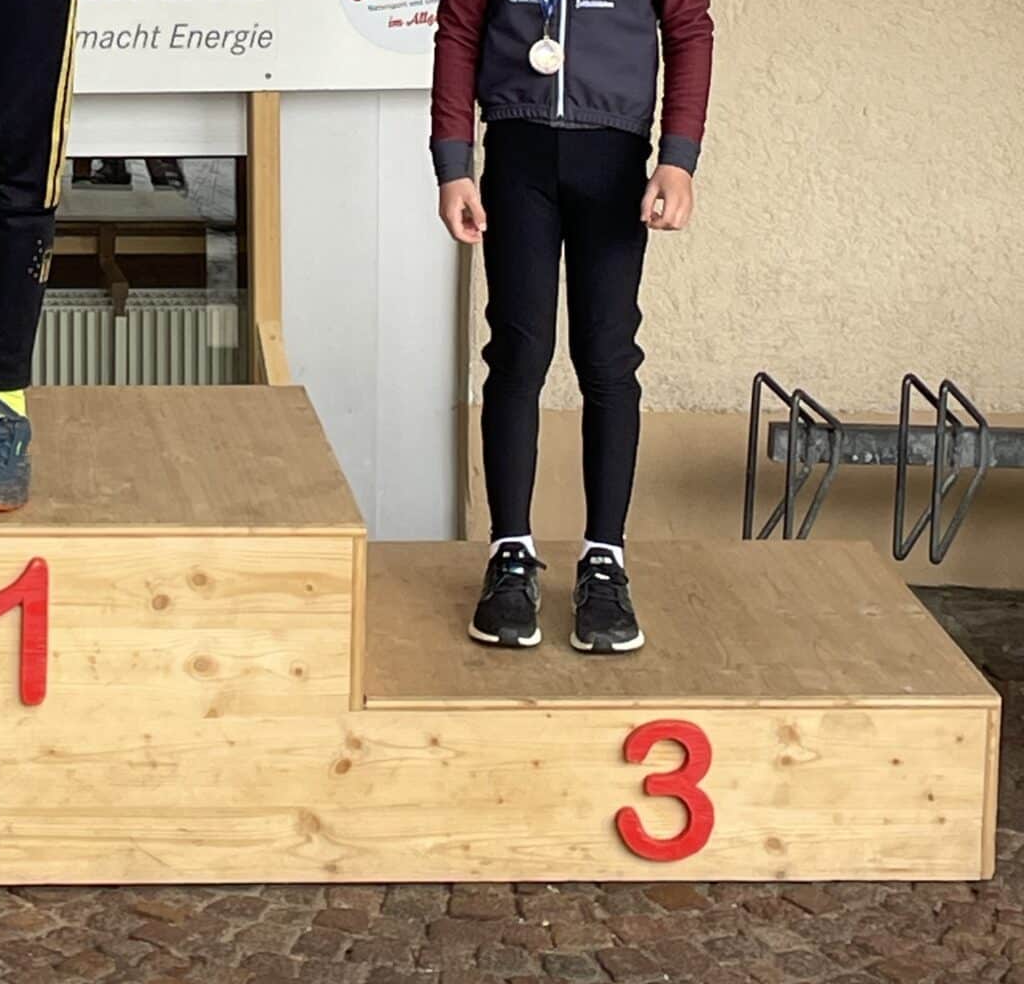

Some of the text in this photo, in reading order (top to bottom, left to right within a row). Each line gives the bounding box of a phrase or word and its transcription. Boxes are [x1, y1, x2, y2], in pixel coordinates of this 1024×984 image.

[406, 11, 438, 27] Allg
[76, 23, 273, 56] macht Energie
[615, 719, 715, 863] 3
